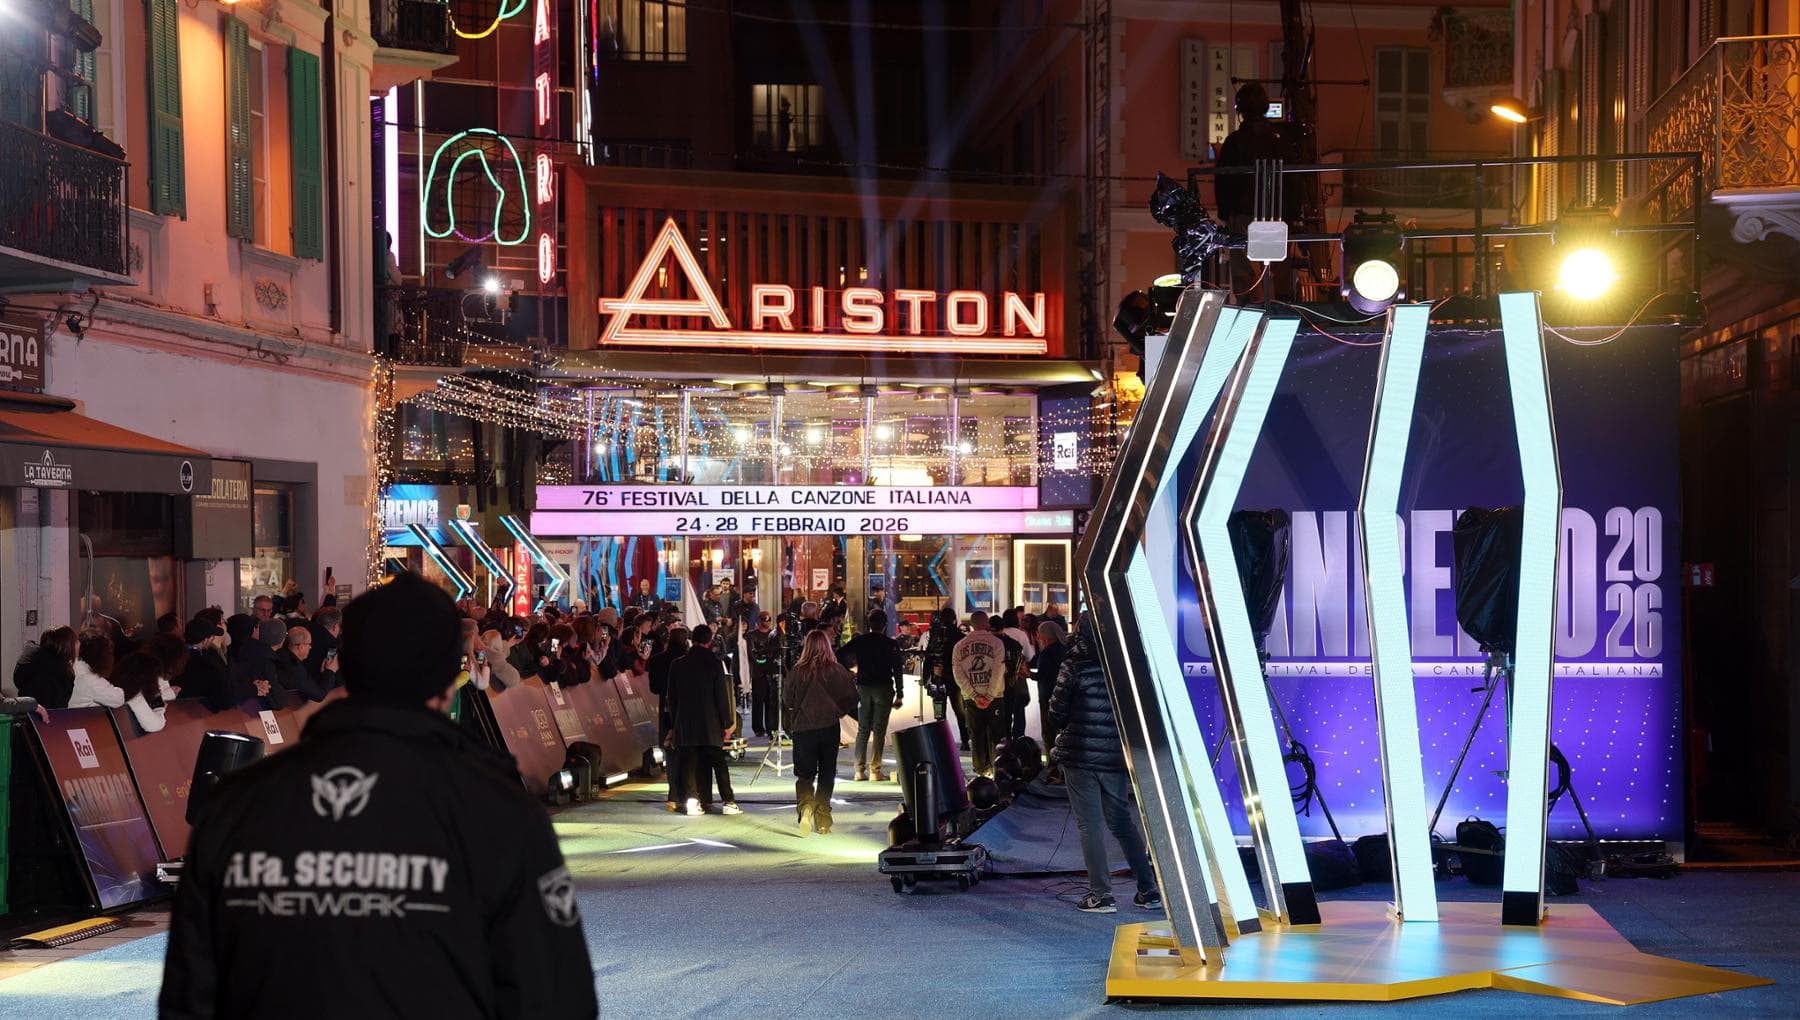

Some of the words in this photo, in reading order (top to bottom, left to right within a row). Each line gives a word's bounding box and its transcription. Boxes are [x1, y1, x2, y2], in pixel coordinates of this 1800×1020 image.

[600, 217, 1046, 345] ARISTON
[1057, 442, 1074, 459] Rai
[24, 466, 34, 478] LA
[36, 466, 72, 480] TAVERNA
[621, 491, 709, 506] FESTIVAL
[721, 490, 780, 506] DELLA
[791, 490, 876, 505] CANZONE
[890, 490, 972, 505] ITALIANA
[379, 500, 427, 527] REMO
[752, 517, 845, 532] FEBBRAIO
[860, 517, 909, 532] 2026
[1605, 506, 1663, 582] 20
[517, 543, 528, 605] CINEMA
[1605, 583, 1663, 658] 26
[1562, 665, 1660, 676] TALIANA
[264, 719, 279, 735] Rai
[74, 739, 94, 757] Rai
[295, 851, 449, 892] SECURITY
[257, 891, 406, 918] NETWORK
